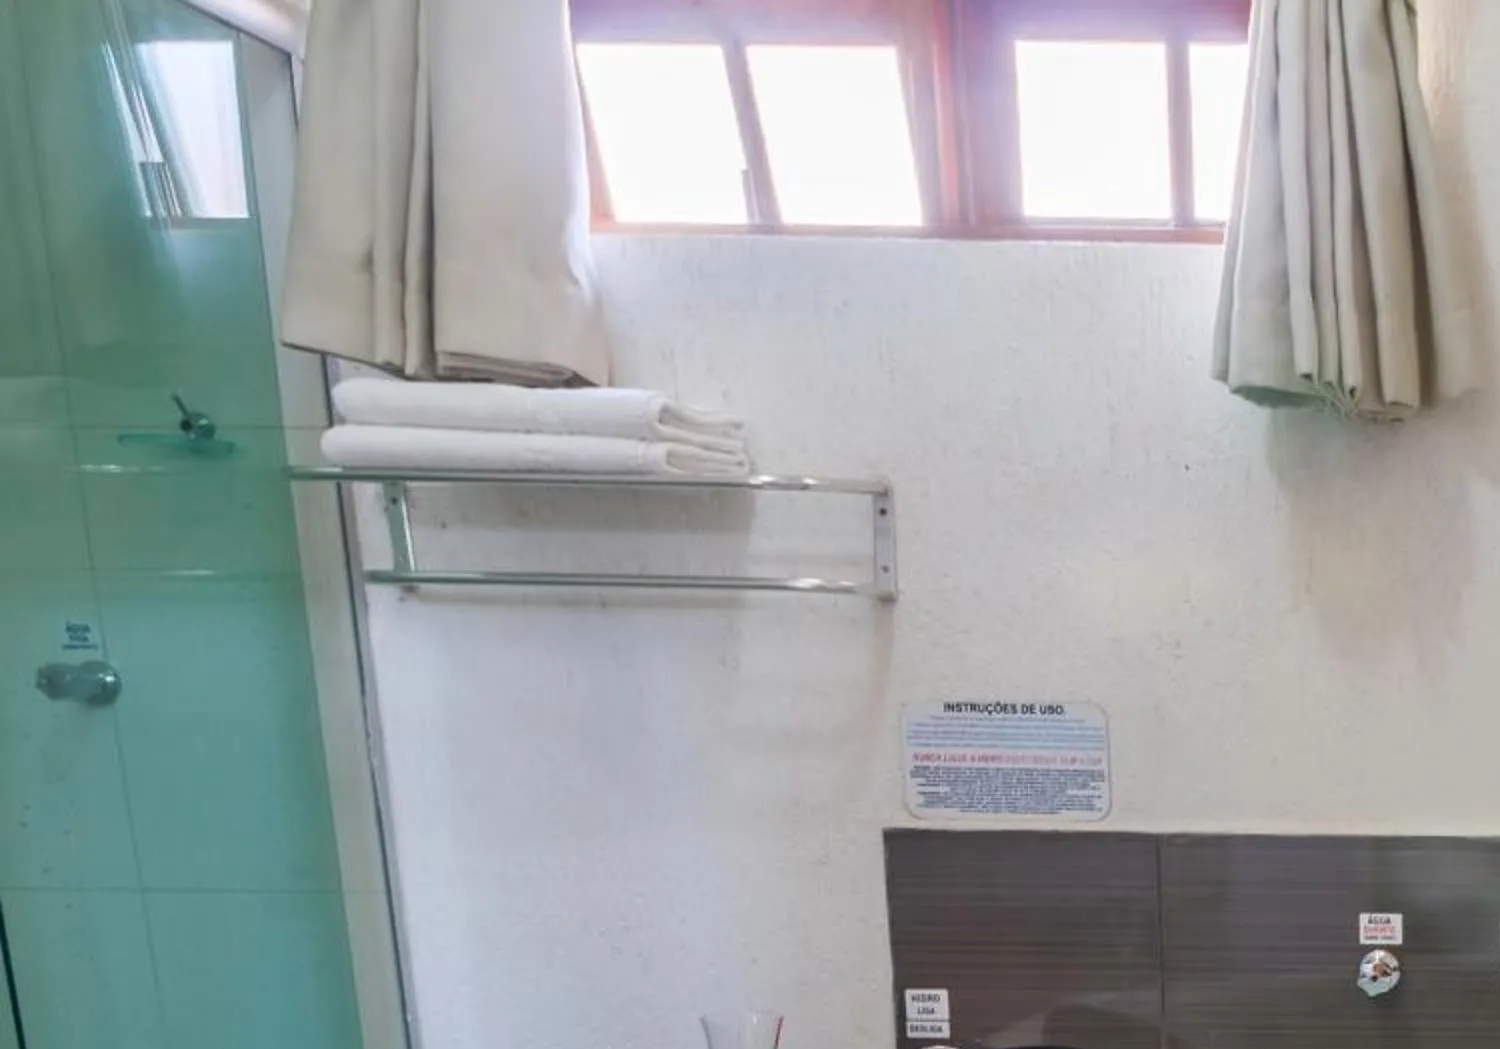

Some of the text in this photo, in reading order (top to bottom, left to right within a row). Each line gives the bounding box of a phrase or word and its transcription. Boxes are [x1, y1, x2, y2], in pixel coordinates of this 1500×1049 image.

[943, 702, 1064, 716] INSTRUÇÕES DE USO
